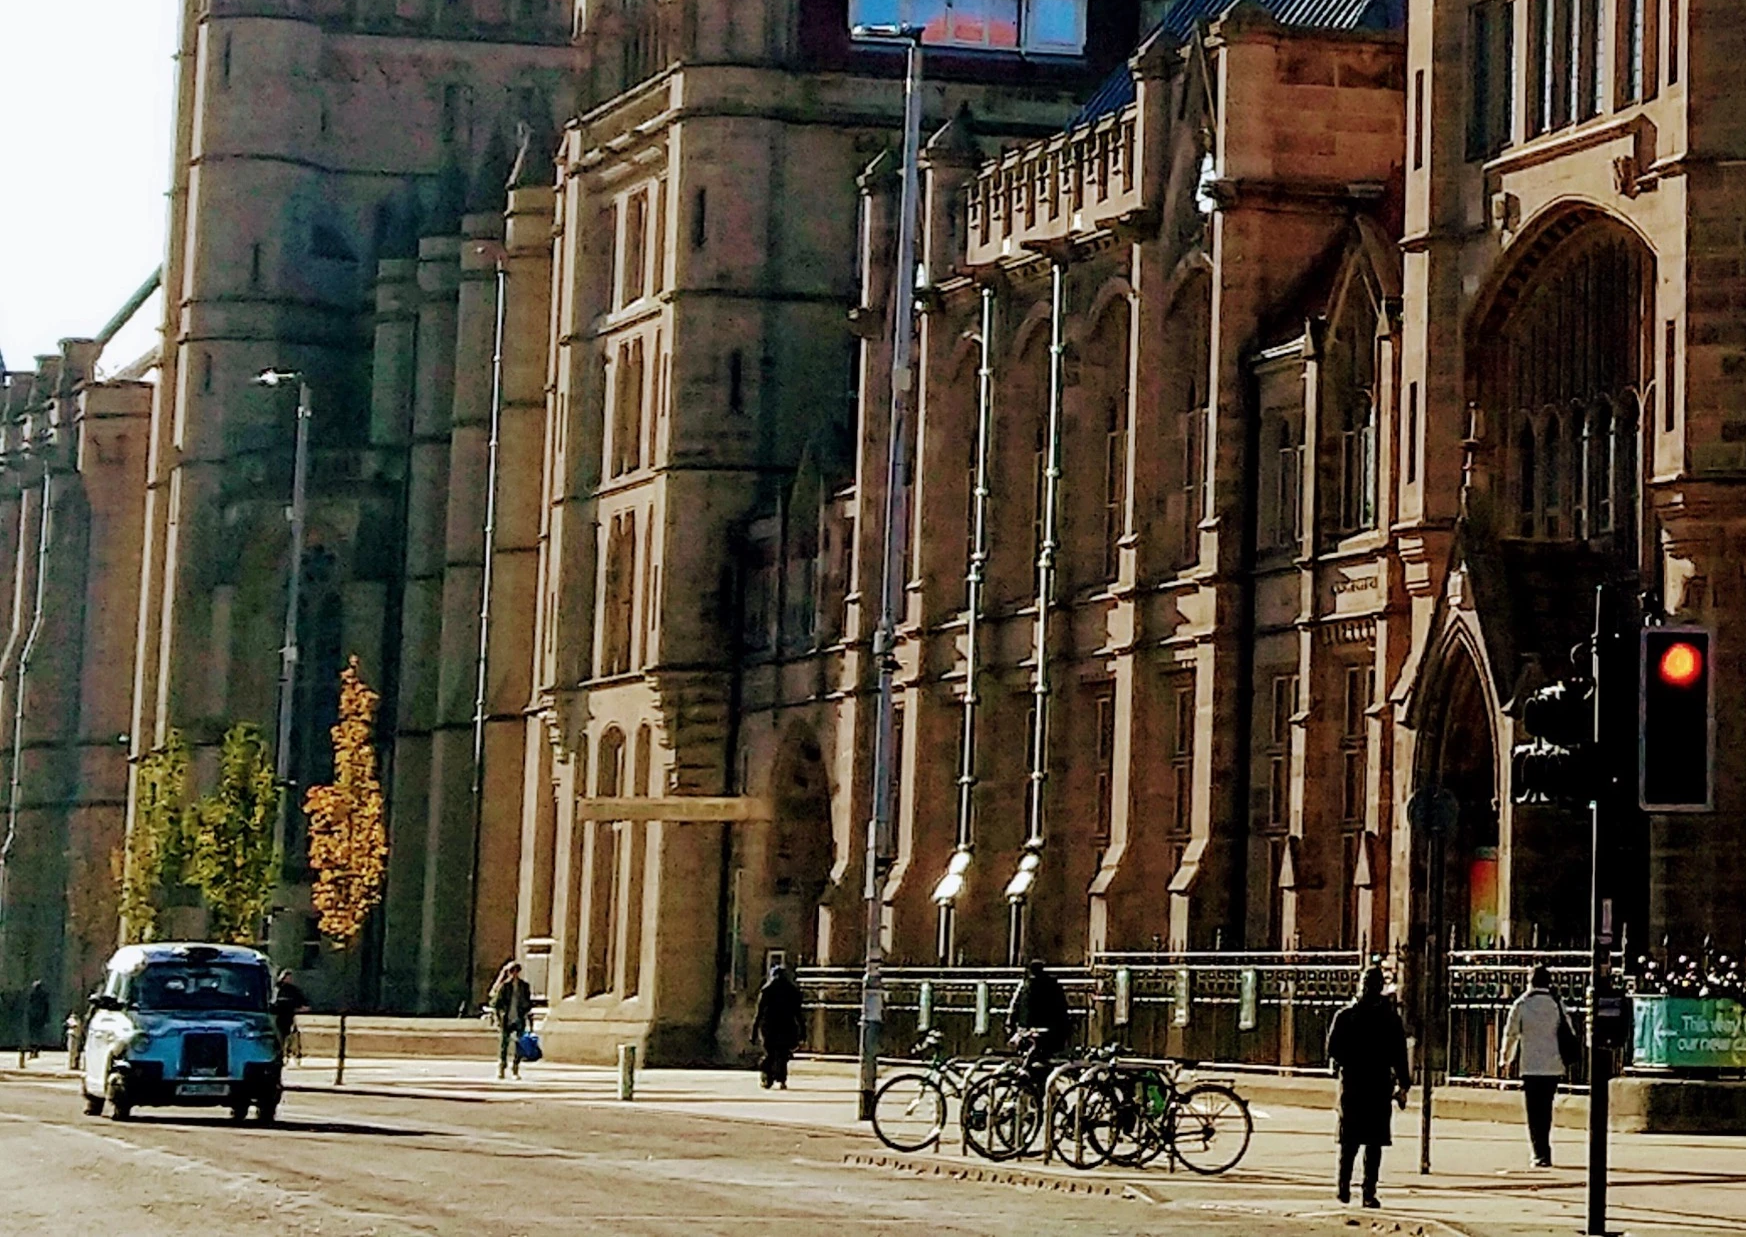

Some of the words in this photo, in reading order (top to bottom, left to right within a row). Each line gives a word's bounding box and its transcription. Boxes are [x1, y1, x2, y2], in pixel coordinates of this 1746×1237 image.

[1681, 1015, 1708, 1032] This
[1711, 1019, 1741, 1037] way
[1678, 1037, 1699, 1051] our
[1700, 1037, 1730, 1051] new
